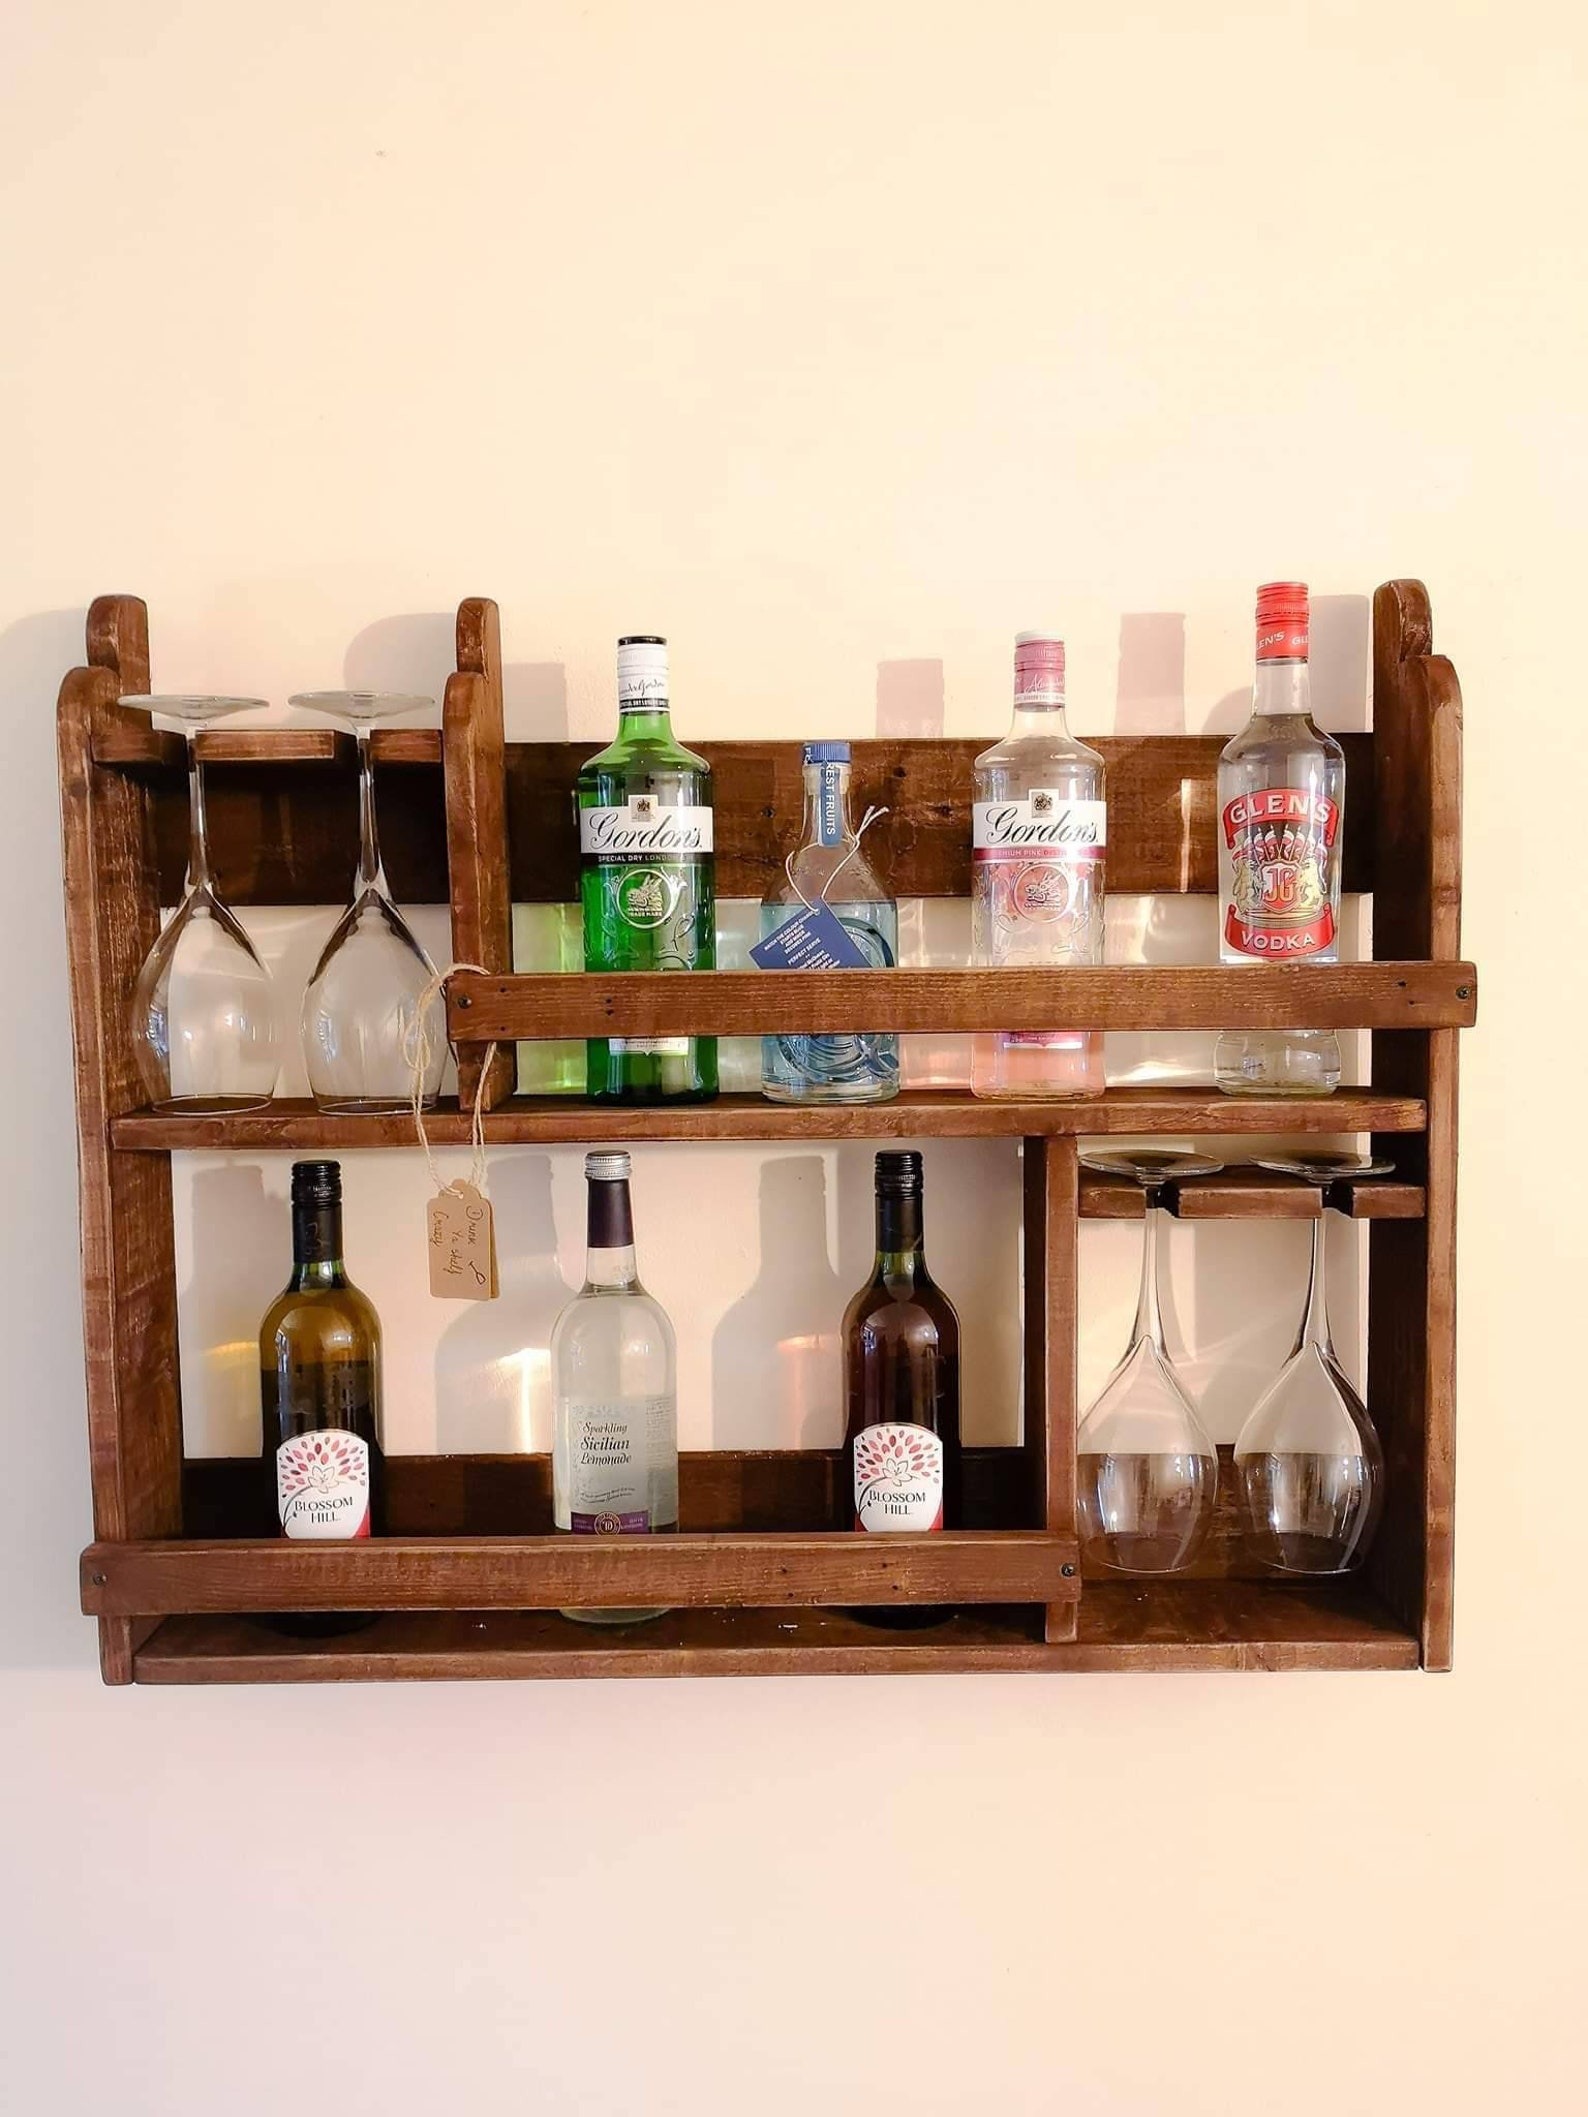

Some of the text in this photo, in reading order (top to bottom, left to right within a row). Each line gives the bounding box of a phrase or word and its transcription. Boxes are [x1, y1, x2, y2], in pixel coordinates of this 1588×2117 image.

[1257, 631, 1286, 650] LEN'S
[825, 795, 836, 835] FRUITS
[598, 854, 626, 863] SPECIAL
[628, 854, 643, 862] DRY
[1241, 930, 1316, 951] VODKA
[582, 1421, 628, 1436] Sparkling
[580, 1437, 630, 1451] Sicilian
[580, 1452, 632, 1466] Lemonade
[869, 1489, 926, 1503] BLOSSOM
[294, 1496, 353, 1512] BLOSSOM
[884, 1504, 911, 1515] HILL
[311, 1511, 342, 1524] HILL
